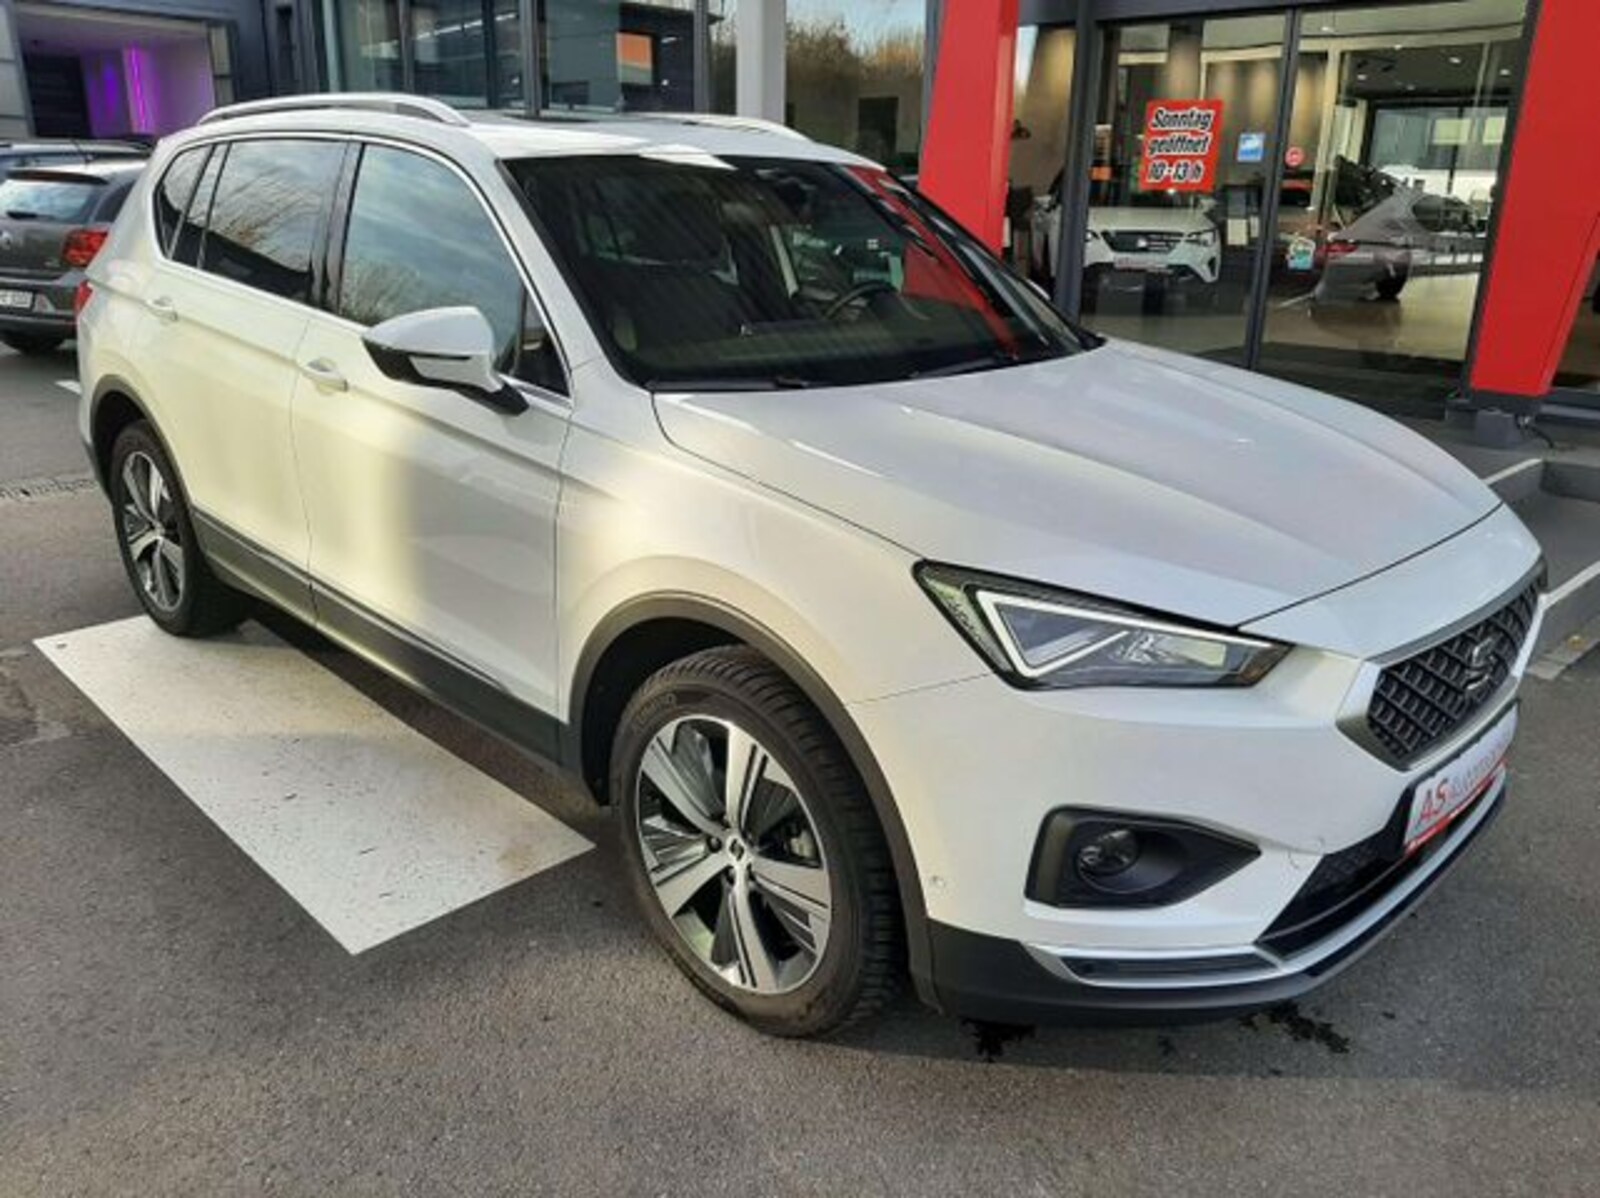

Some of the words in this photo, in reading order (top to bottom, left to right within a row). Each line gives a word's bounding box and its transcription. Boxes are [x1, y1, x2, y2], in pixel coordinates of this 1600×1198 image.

[1152, 107, 1213, 131] Sonntag
[1149, 133, 1210, 157] geöffnet
[1190, 162, 1203, 181] h
